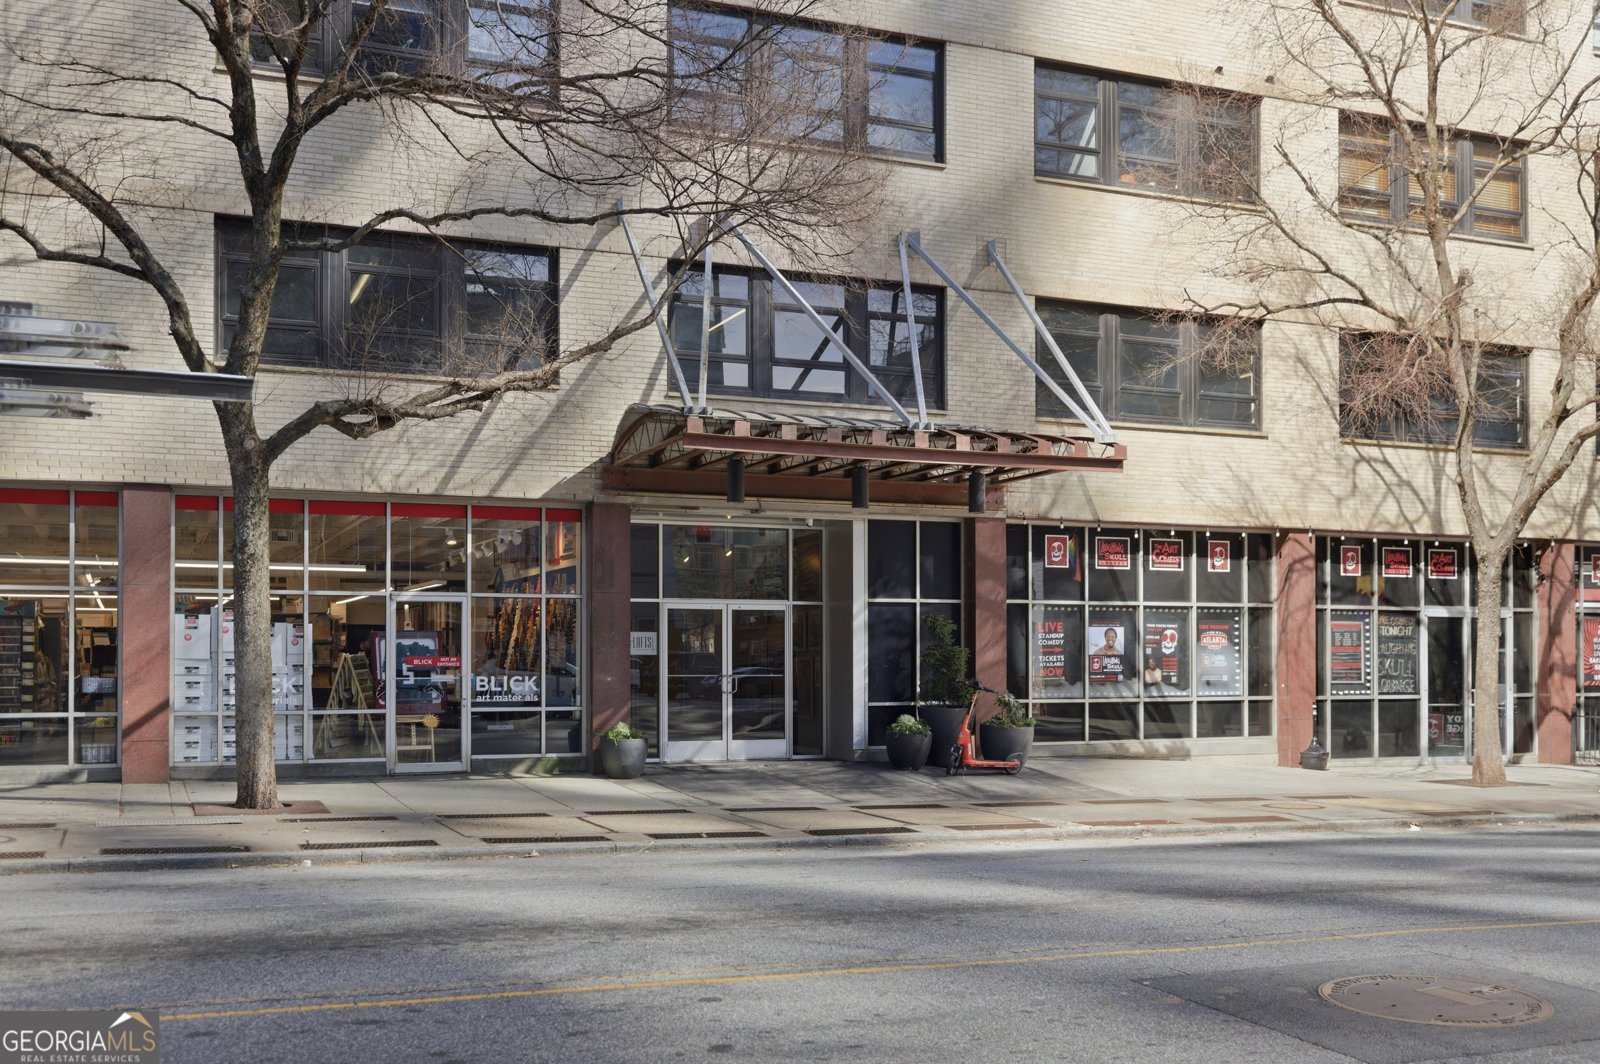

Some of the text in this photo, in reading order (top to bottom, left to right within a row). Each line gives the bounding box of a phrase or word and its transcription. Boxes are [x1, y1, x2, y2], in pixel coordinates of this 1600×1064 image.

[1161, 542, 1179, 554] ART
[1104, 552, 1127, 560] SKULL
[1037, 622, 1064, 632] LIVE
[1380, 626, 1413, 636] TONIGHT
[632, 636, 652, 648] LOFTS
[1202, 636, 1226, 644] ATLANTA
[1040, 668, 1064, 676] NOW
[476, 675, 538, 691] BLICK
